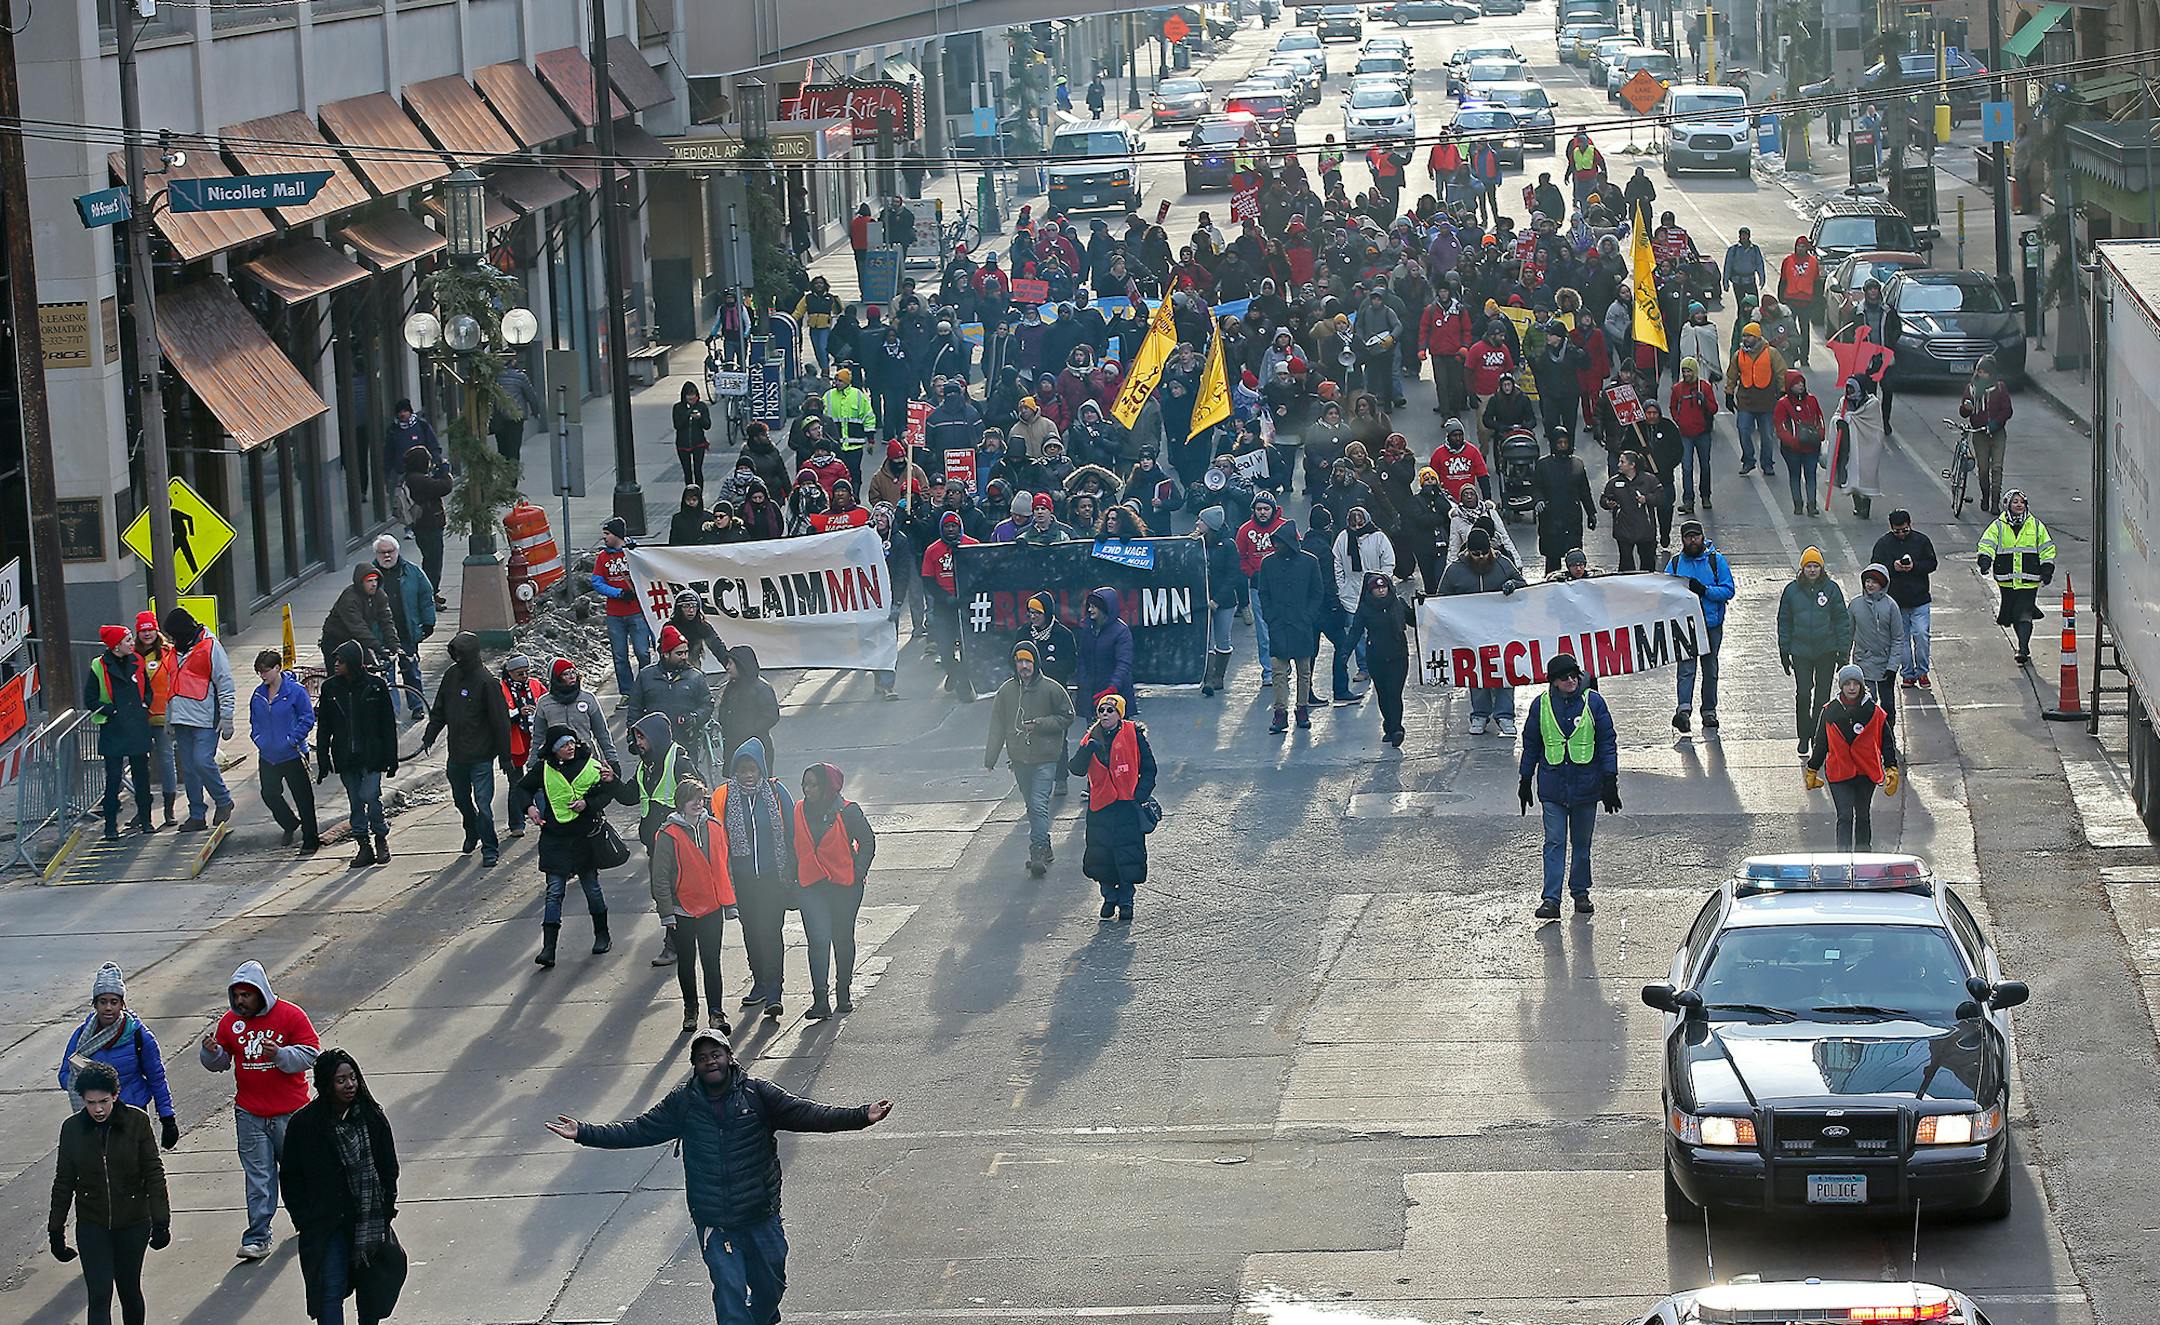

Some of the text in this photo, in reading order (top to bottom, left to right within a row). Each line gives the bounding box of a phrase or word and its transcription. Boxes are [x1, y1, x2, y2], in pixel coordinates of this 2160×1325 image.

[674, 145, 721, 160] MEDICAL
[207, 180, 306, 201] Nicollet Mall
[46, 313, 86, 323] LEASING
[40, 324, 87, 334] ORMATION
[750, 362, 766, 420] PIONEER
[765, 381, 779, 420] PRESS
[827, 514, 849, 525] FAIR
[1102, 545, 1149, 557] END WAGE
[0, 579, 12, 610] AD
[0, 611, 18, 646] SED
[1816, 1183, 1858, 1198] POLICE
